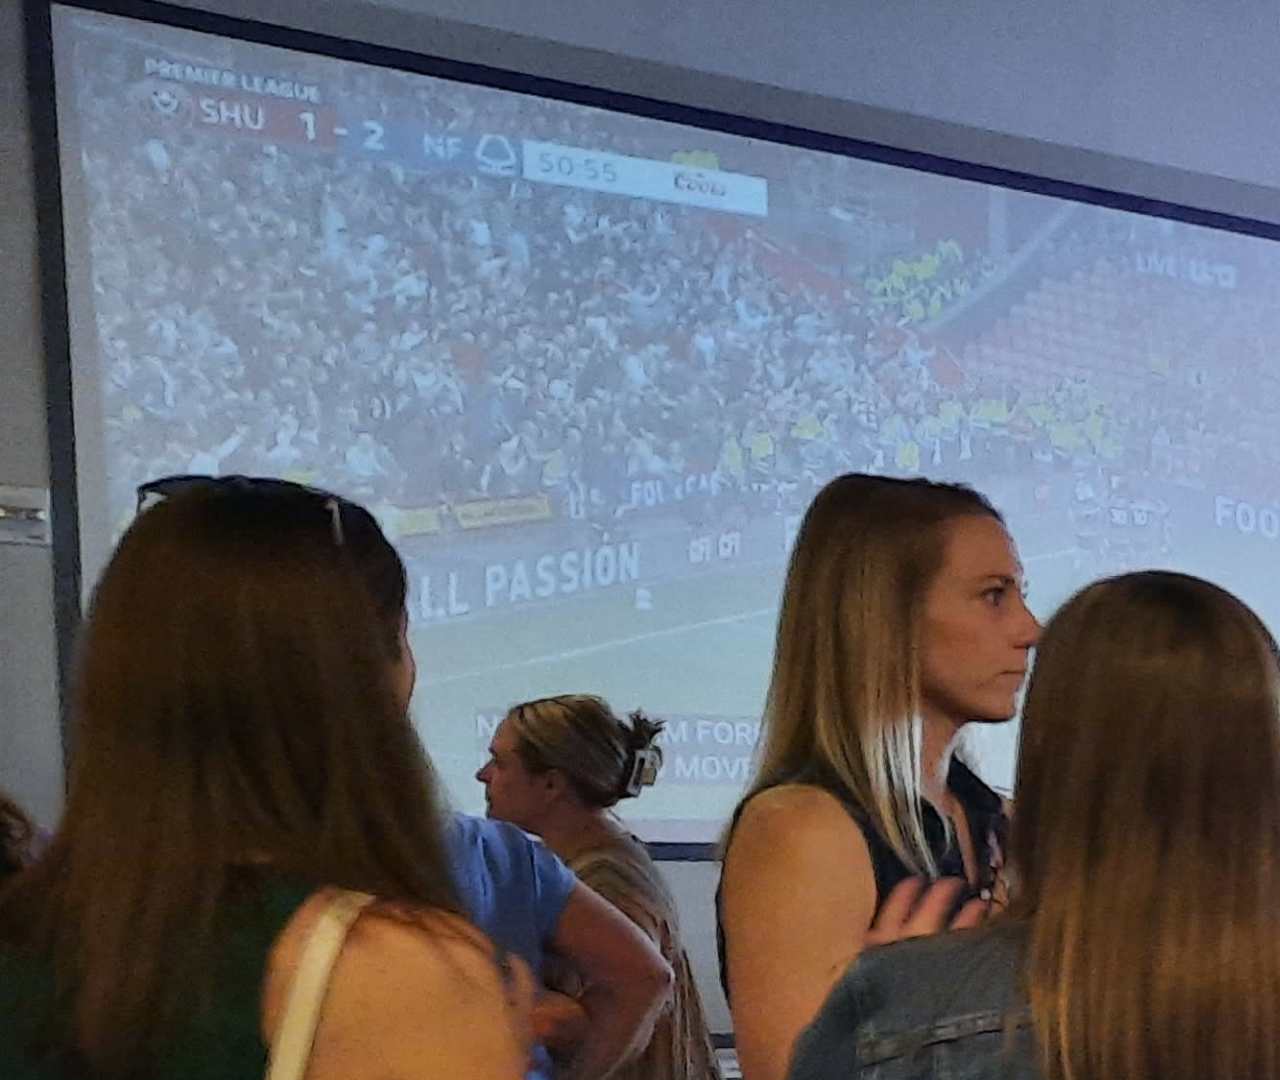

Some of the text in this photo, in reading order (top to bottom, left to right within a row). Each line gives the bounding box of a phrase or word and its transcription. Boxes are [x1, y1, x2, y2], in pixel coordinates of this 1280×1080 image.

[145, 57, 320, 103] PREMIER LEAGUE
[200, 99, 265, 130] SHU
[299, 112, 317, 141] 1
[363, 120, 385, 150] 2
[485, 540, 642, 608] PASSION
